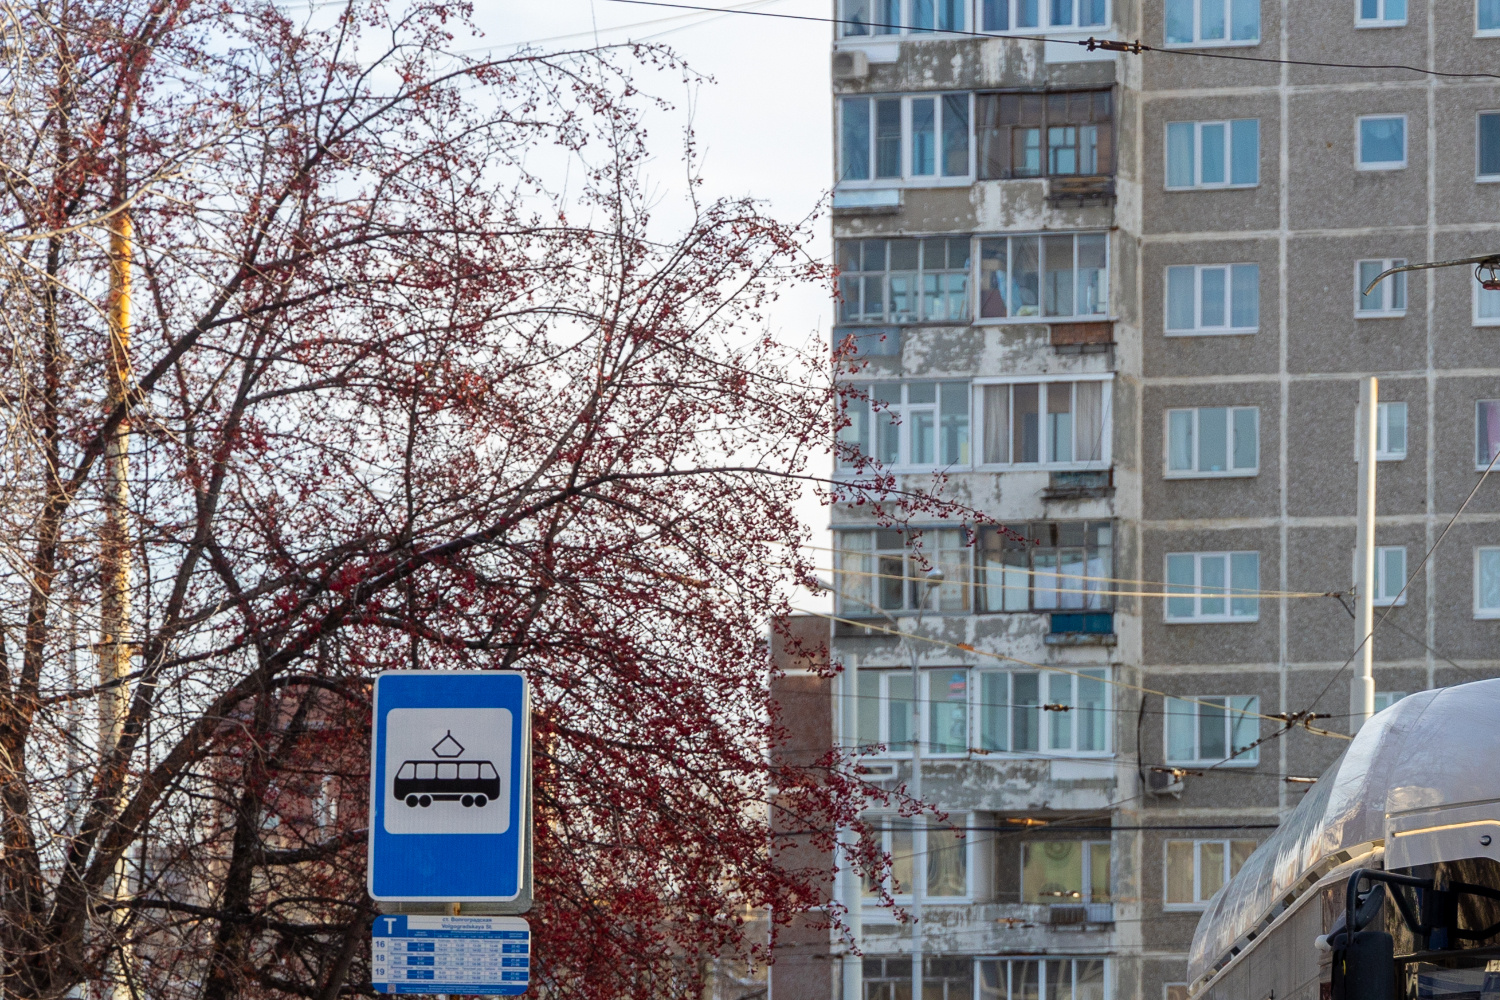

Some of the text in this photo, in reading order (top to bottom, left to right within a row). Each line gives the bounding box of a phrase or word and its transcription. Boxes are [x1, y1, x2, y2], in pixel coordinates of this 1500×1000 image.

[375, 940, 386, 948] 16
[375, 954, 386, 962] 18
[375, 968, 386, 976] 19
